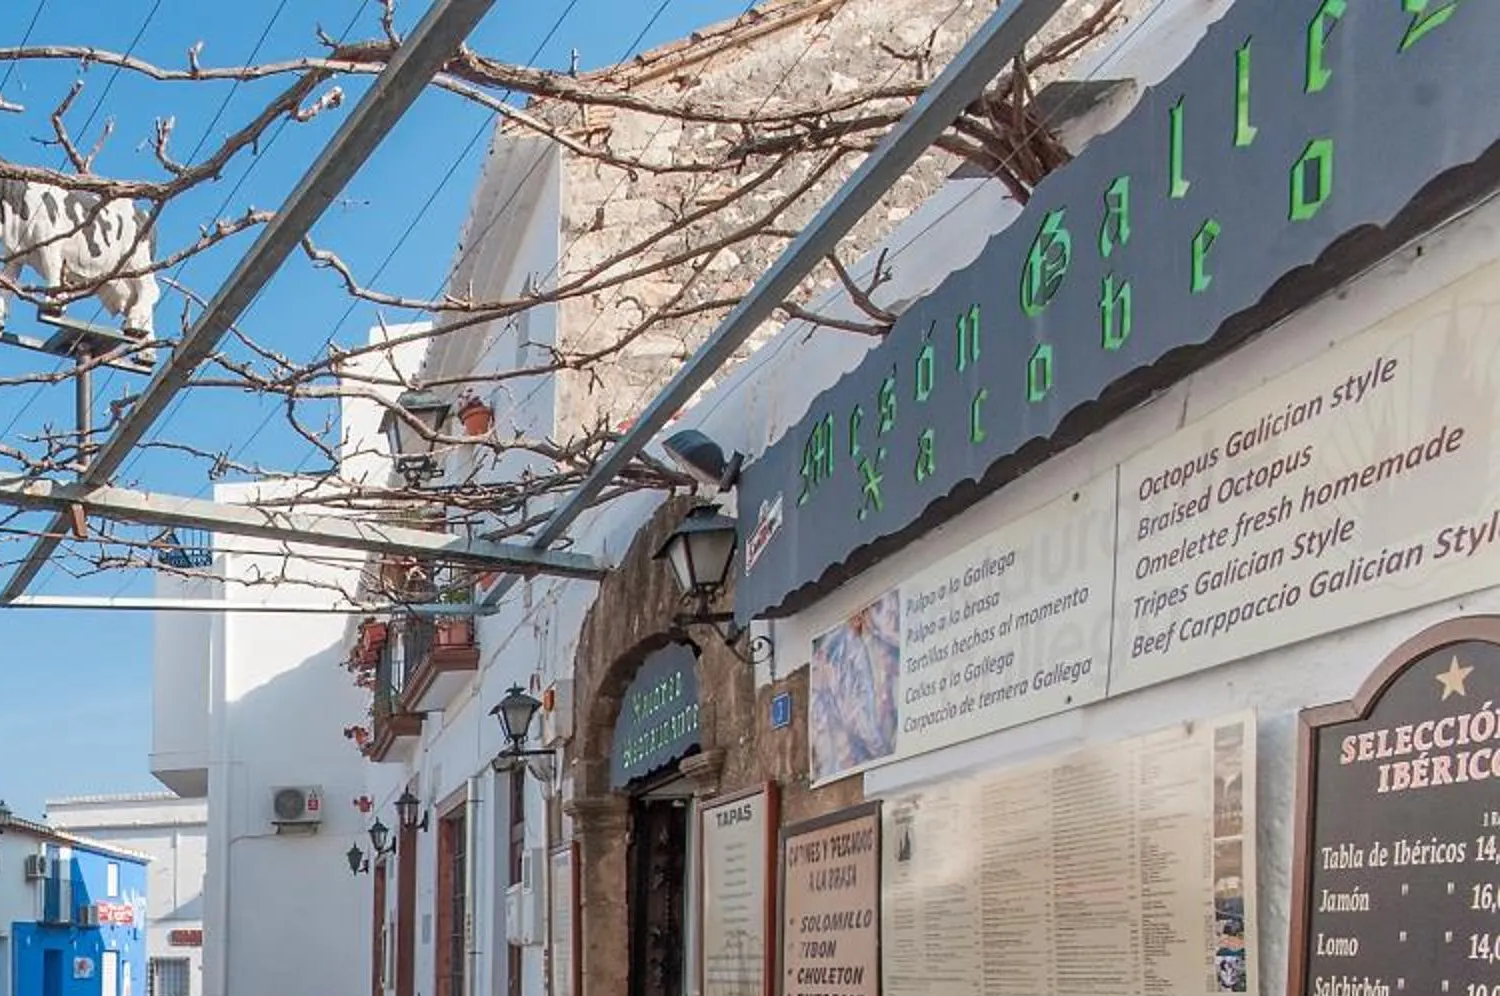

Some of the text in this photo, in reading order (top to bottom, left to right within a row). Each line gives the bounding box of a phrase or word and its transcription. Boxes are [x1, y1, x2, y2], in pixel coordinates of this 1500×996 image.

[855, 137, 1333, 521] Xacobeo
[1139, 356, 1397, 501] Octopus Galician style
[1135, 524, 1229, 580] Omelette
[1231, 496, 1293, 547] fresh
[1300, 425, 1465, 513] homemade
[1137, 444, 1313, 540] Braised Octopus
[906, 551, 1015, 616] Pulpo a la Gallega
[1131, 625, 1177, 658] Beef
[1179, 584, 1300, 642] Carppaccio
[1309, 543, 1423, 598] Galician
[1433, 510, 1500, 559] Styl
[1133, 517, 1355, 619] Tripes Galician Style
[906, 592, 1000, 645] Pulpo a la brasa
[906, 643, 949, 673] Tortillas
[952, 627, 996, 657] hechas
[999, 613, 1013, 637] al
[1015, 586, 1089, 631] momento
[939, 677, 947, 691] a
[950, 671, 961, 688] la
[964, 651, 1015, 682] Gallega
[959, 695, 975, 714] de
[977, 678, 1028, 710] ternera
[1032, 655, 1092, 692] Gallega
[1340, 701, 1500, 764] SELECCIÓ
[716, 804, 752, 827] TAPAS
[1321, 843, 1364, 870] Tabla
[1368, 841, 1389, 867] de
[1394, 837, 1467, 866] Ibéricos
[801, 909, 873, 933] SOLOMILLO
[1319, 886, 1371, 912] Jamón
[797, 966, 864, 985] CHULETON
[1316, 933, 1359, 957] Lomo
